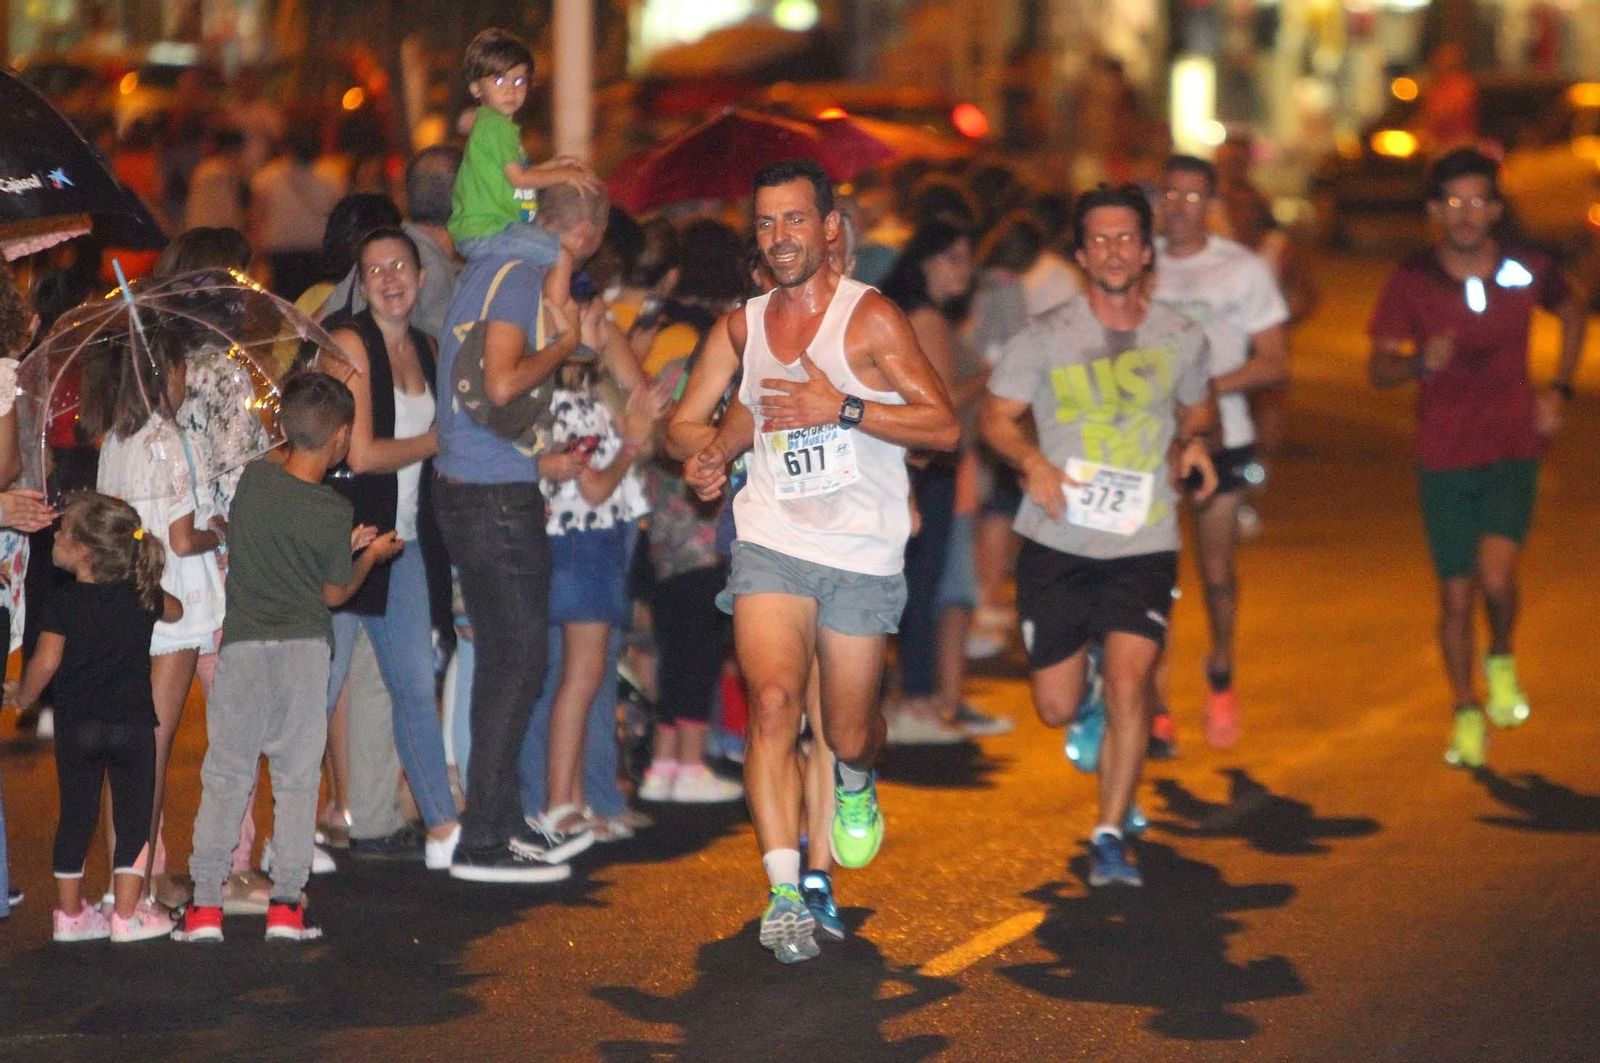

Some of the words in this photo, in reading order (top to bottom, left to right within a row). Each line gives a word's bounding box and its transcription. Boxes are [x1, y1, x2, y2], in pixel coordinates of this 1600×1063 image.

[787, 440, 800, 450] DE
[802, 430, 839, 448] HUELVA
[783, 445, 826, 477] 677
[1079, 483, 1126, 513] 572
